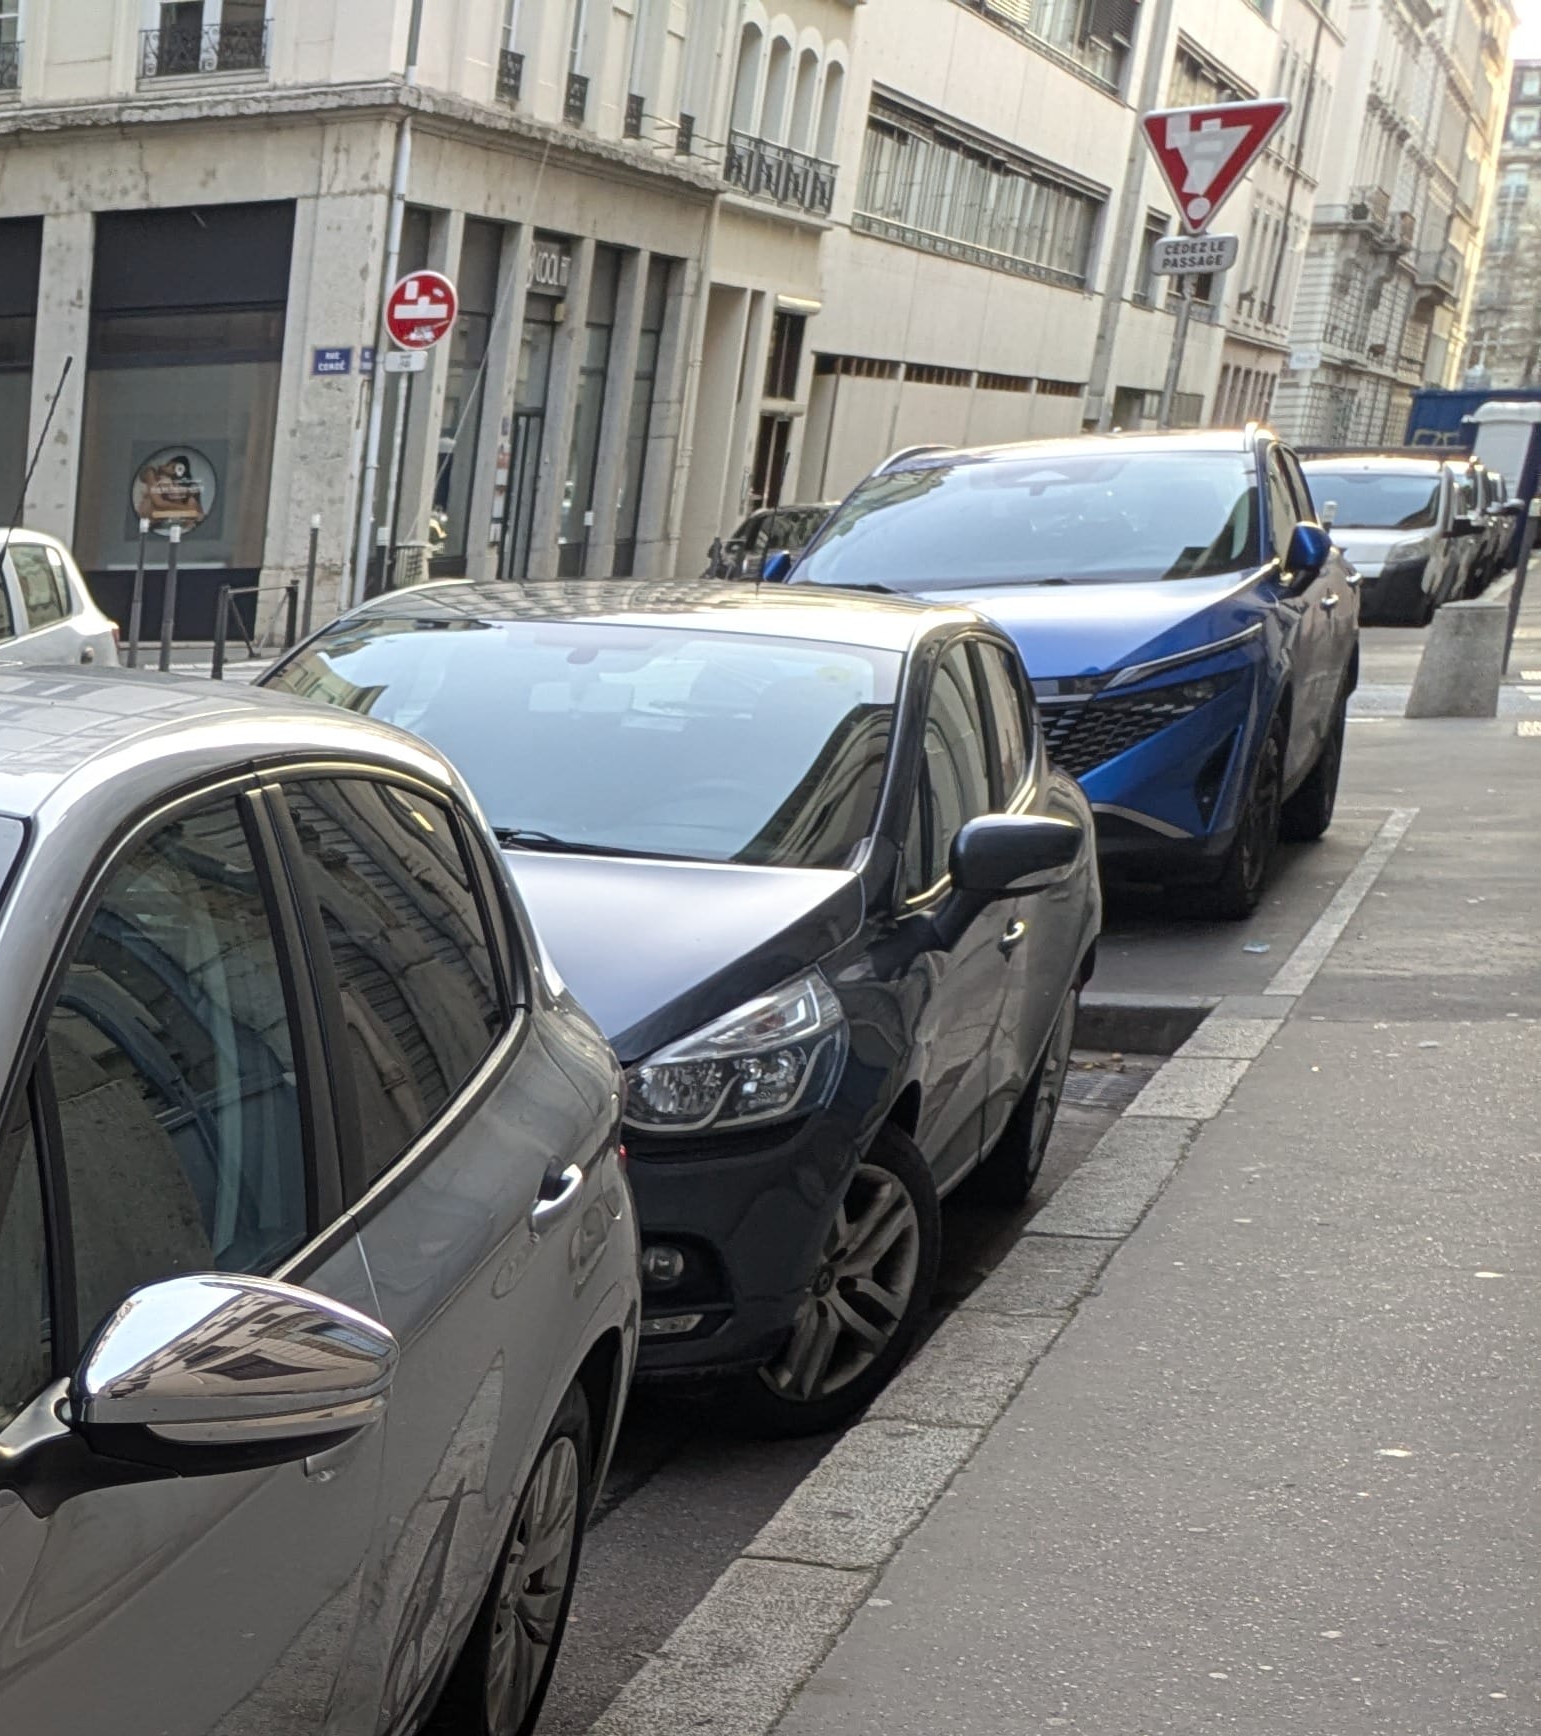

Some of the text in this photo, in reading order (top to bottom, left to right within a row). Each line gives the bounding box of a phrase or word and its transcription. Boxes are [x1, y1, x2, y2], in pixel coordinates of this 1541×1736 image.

[1210, 240, 1226, 253] LE
[1162, 254, 1223, 269] PASSAGE
[325, 351, 342, 360] RUE
